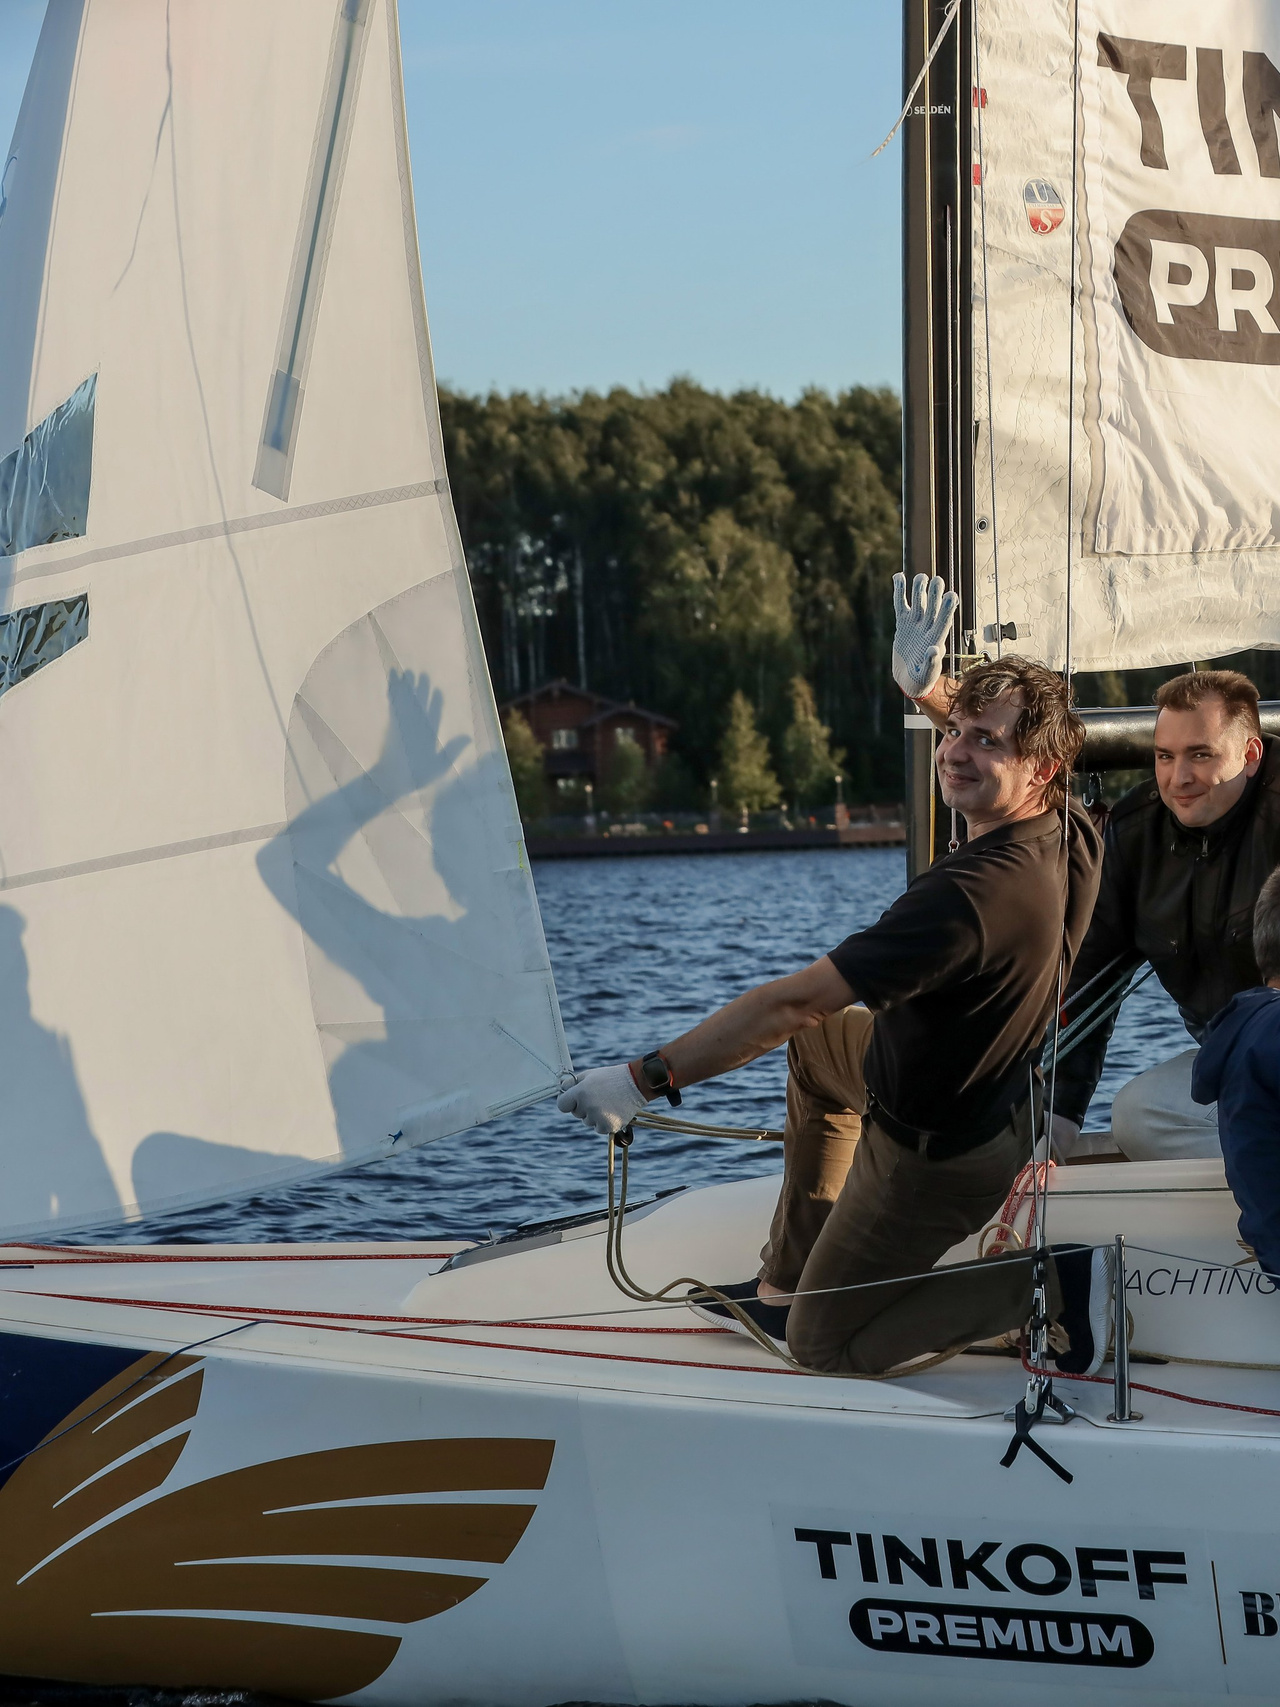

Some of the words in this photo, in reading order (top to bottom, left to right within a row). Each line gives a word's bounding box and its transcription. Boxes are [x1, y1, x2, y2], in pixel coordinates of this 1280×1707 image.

[914, 103, 951, 115] SEDÉN
[1123, 1267, 1278, 1296] ACHTING
[794, 1527, 1187, 1600] TINKOFF
[867, 1608, 1135, 1659] PREMIUM
